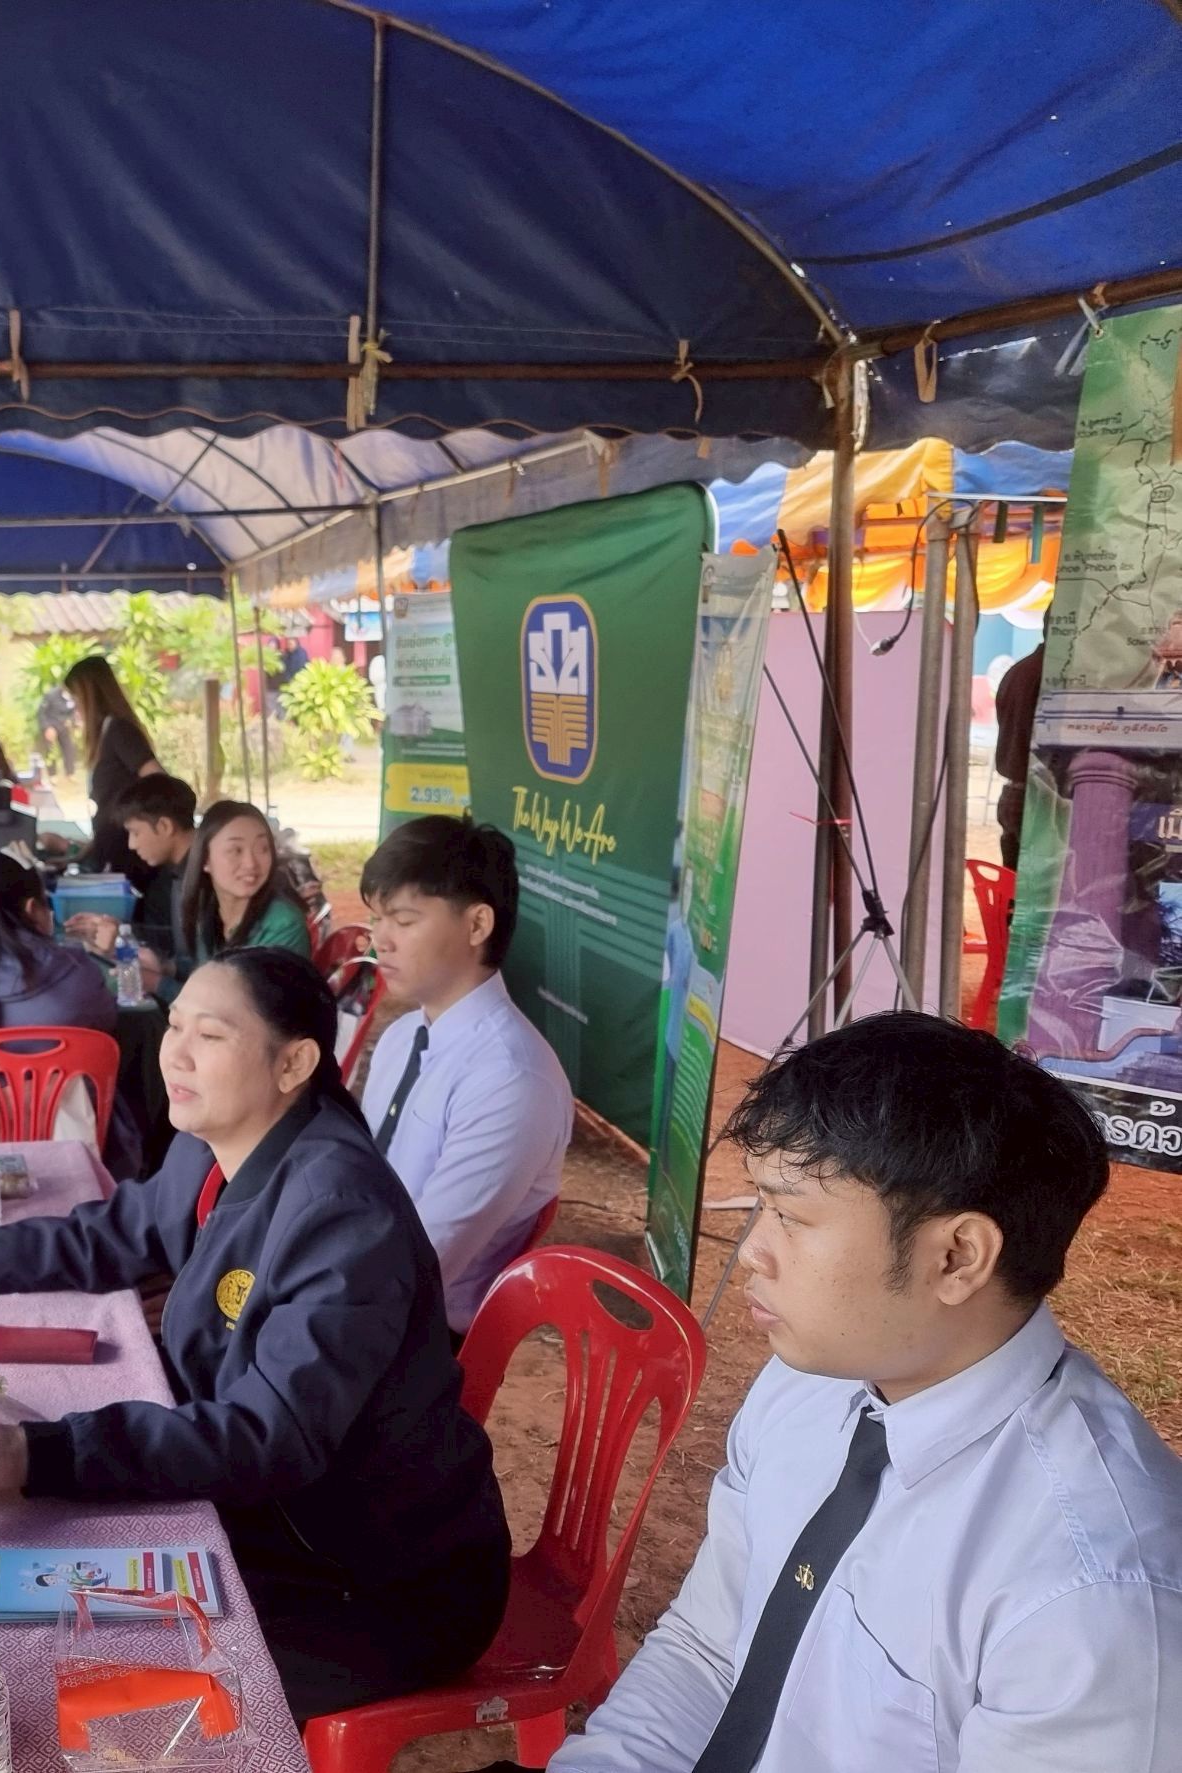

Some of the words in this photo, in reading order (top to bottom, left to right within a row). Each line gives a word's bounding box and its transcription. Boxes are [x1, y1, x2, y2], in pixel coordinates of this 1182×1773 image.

[512, 786, 531, 832] The
[530, 791, 559, 857] Way
[583, 804, 617, 865] Are
